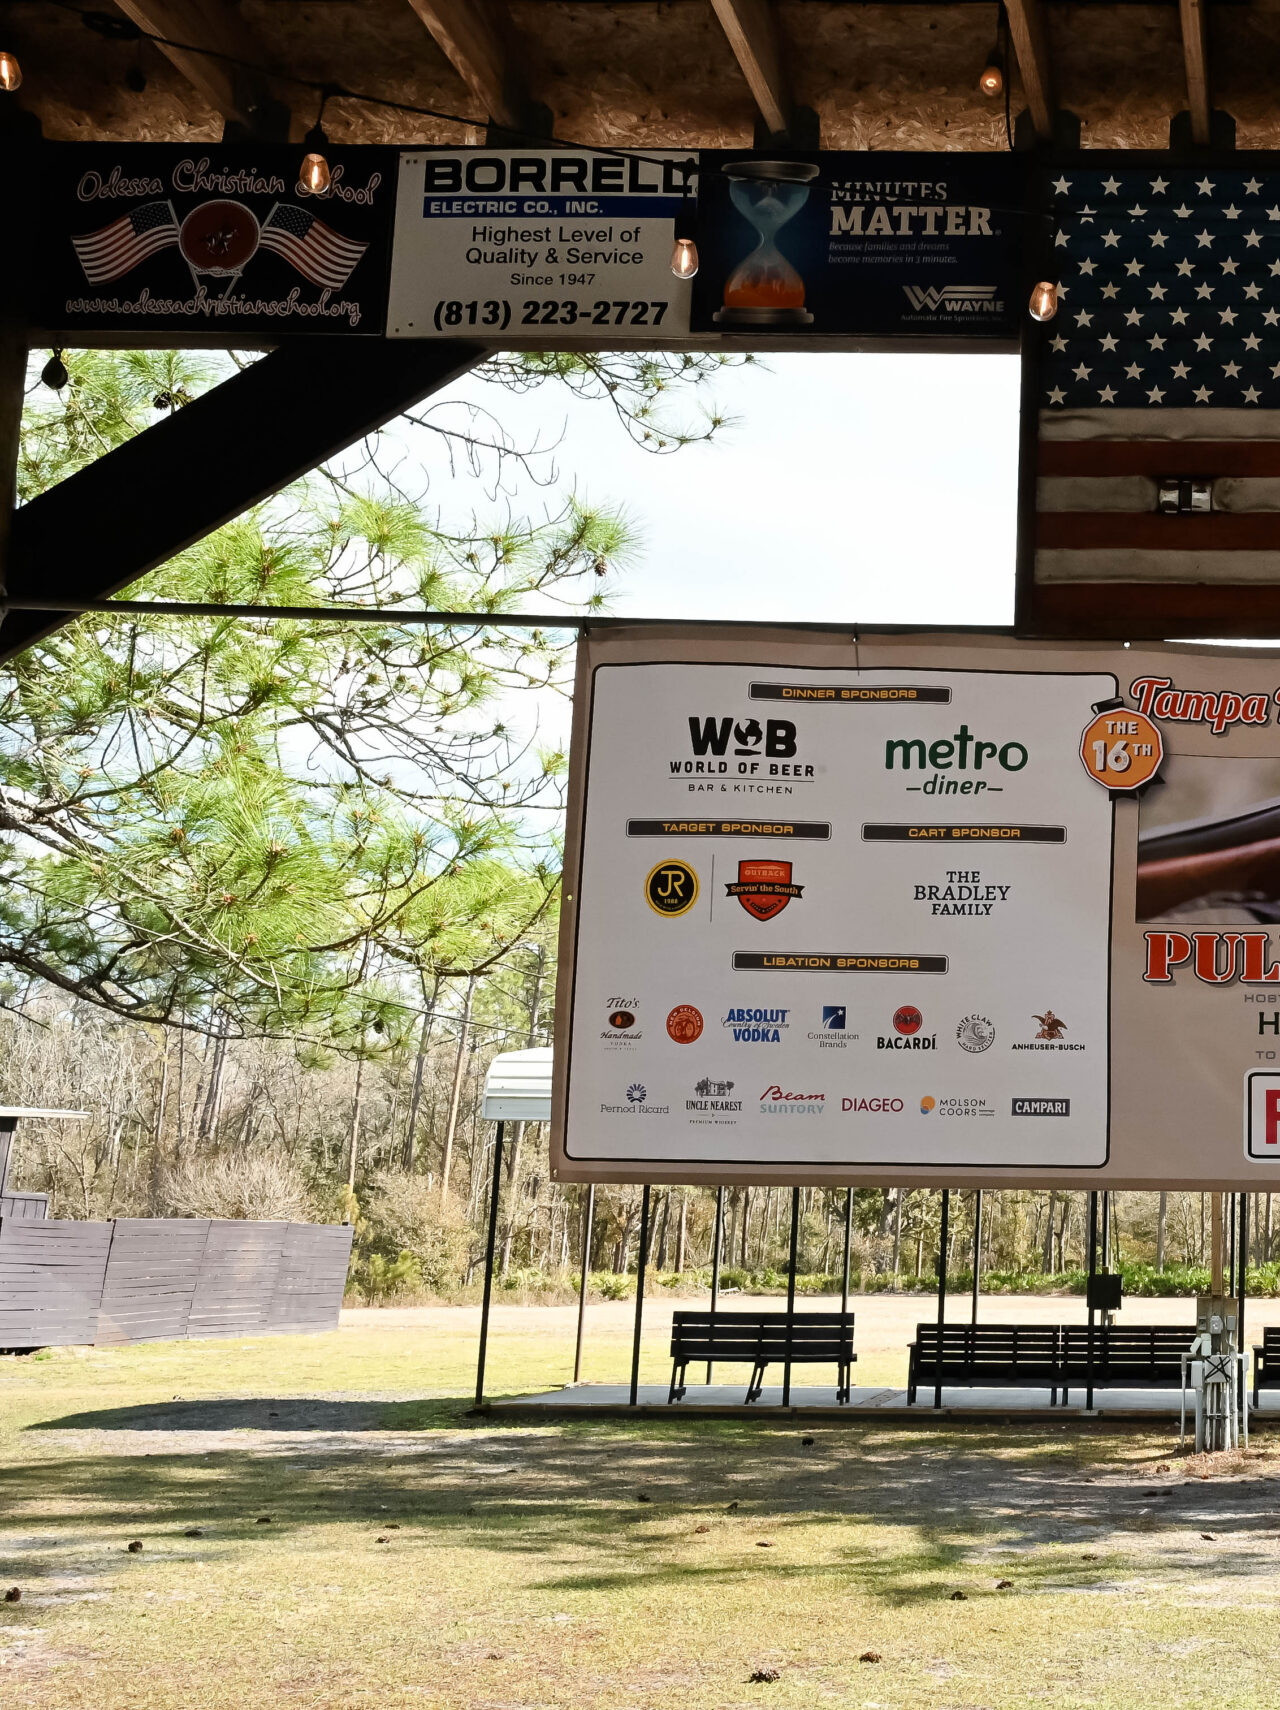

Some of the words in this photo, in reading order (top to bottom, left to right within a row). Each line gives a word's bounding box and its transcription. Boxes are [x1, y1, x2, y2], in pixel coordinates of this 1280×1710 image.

[77, 166, 163, 201] Odessa
[172, 158, 285, 193] Christian
[424, 158, 692, 194] BORRELL
[831, 181, 948, 201] MINUTES
[430, 202, 517, 214] ELECTRIC
[523, 202, 558, 215] CO.,
[566, 202, 603, 213] INC.
[472, 226, 551, 245] Highest
[559, 227, 612, 242] Level
[620, 227, 640, 242] of
[466, 248, 538, 267] Quality
[546, 248, 559, 264] &
[566, 250, 644, 264] Service
[510, 274, 553, 285] Since
[559, 274, 595, 285] 1947
[66, 288, 361, 326] www.odessachristianschool.org
[944, 301, 1004, 311] WAYNE
[434, 300, 512, 331] (813)
[522, 302, 668, 325] 223-2727
[782, 688, 835, 697] DINNER
[841, 690, 917, 699] SPONSORS
[1131, 677, 1268, 733] Tampa
[1106, 721, 1137, 734] THE
[885, 725, 1028, 771] metro
[670, 761, 727, 773] WORLD
[738, 762, 759, 774] OF
[770, 764, 815, 777] BEER
[688, 784, 714, 792] BAR
[734, 785, 792, 794] KITCHEN
[663, 824, 715, 832] TARGET
[722, 825, 793, 834] SPONSOR
[909, 829, 946, 837] CART
[952, 829, 1020, 838] SPONSOR
[657, 870, 685, 897] JR
[946, 871, 980, 883] THE
[731, 885, 759, 893] Servin'
[774, 886, 798, 895] South
[914, 886, 1010, 900] BRADLEY
[931, 904, 993, 915] FAMILY
[764, 957, 830, 967] LIBATION
[836, 958, 919, 968] SPONSORS
[607, 997, 639, 1008] Tito's
[727, 1009, 787, 1023] ABSOLUT
[601, 1031, 642, 1040] Handmade
[733, 1029, 780, 1043] VODKA
[808, 1032, 859, 1040] Constellation
[877, 1034, 937, 1049] BACARDÍ
[1256, 1051, 1275, 1059] TO
[760, 1086, 825, 1101] Beam
[601, 1104, 637, 1113] Pernod
[638, 1105, 669, 1114] Ricard
[686, 1101, 708, 1111] UNCLE
[711, 1101, 742, 1111] NEAREST
[760, 1104, 824, 1114] SUNTORY
[842, 1098, 903, 1112] DIAGEO
[1016, 1101, 1066, 1114] CAMPARI
[940, 1108, 976, 1116] COORS
